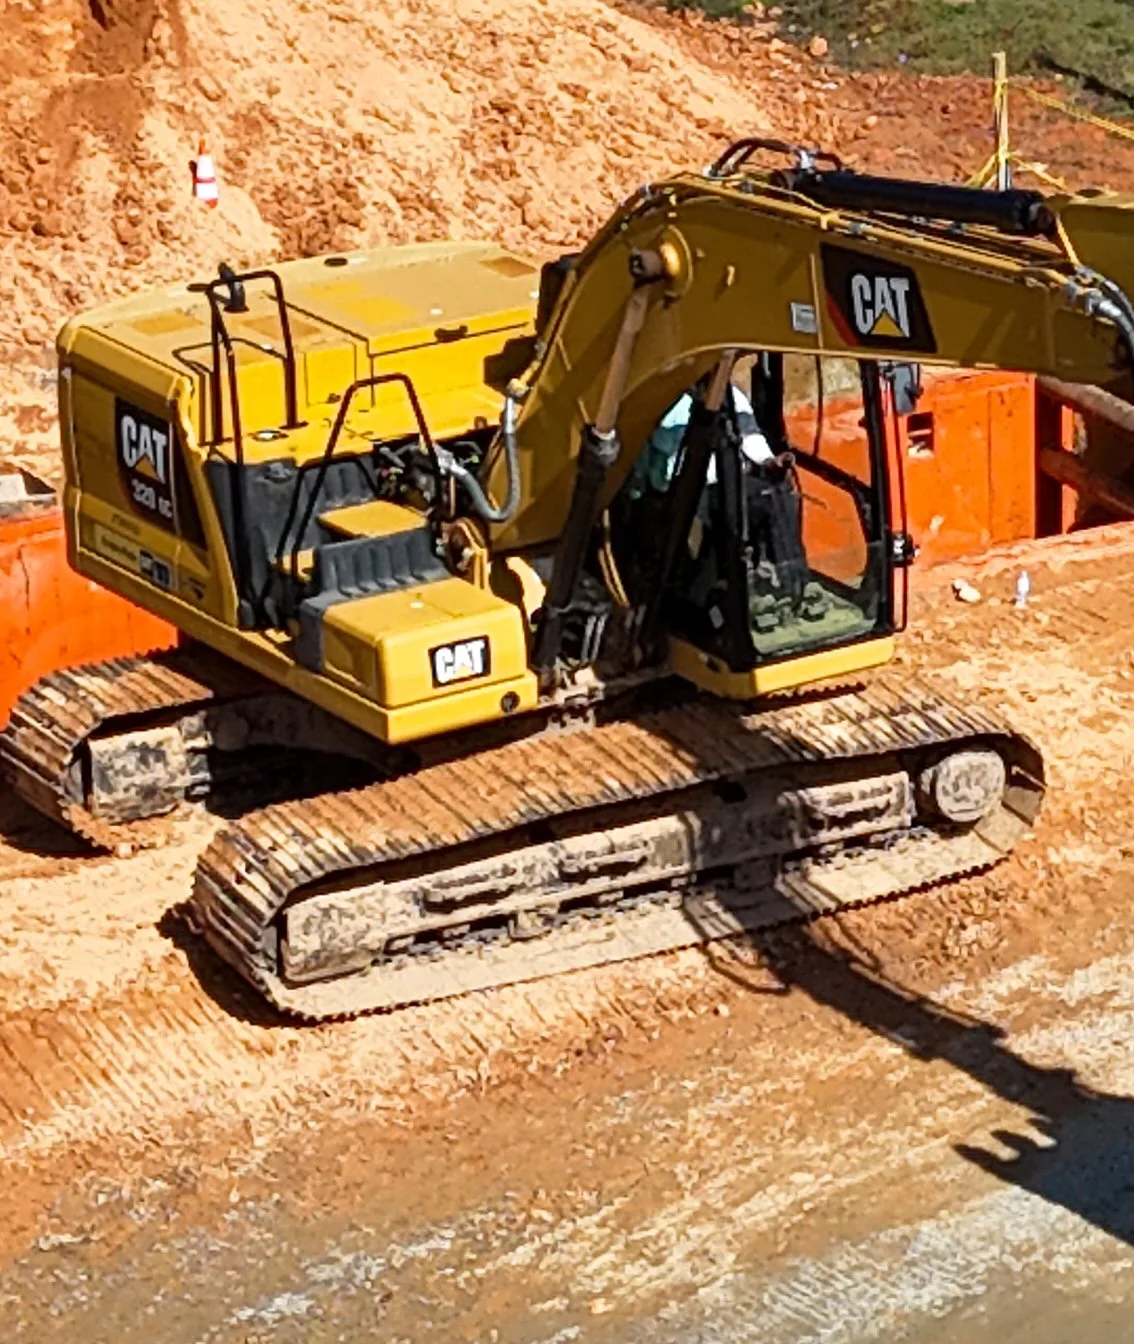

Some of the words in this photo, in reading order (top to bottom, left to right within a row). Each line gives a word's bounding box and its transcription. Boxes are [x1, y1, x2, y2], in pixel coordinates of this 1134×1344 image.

[851, 273, 910, 338] CAT
[121, 415, 168, 484] CAT
[435, 639, 485, 684] CAT
